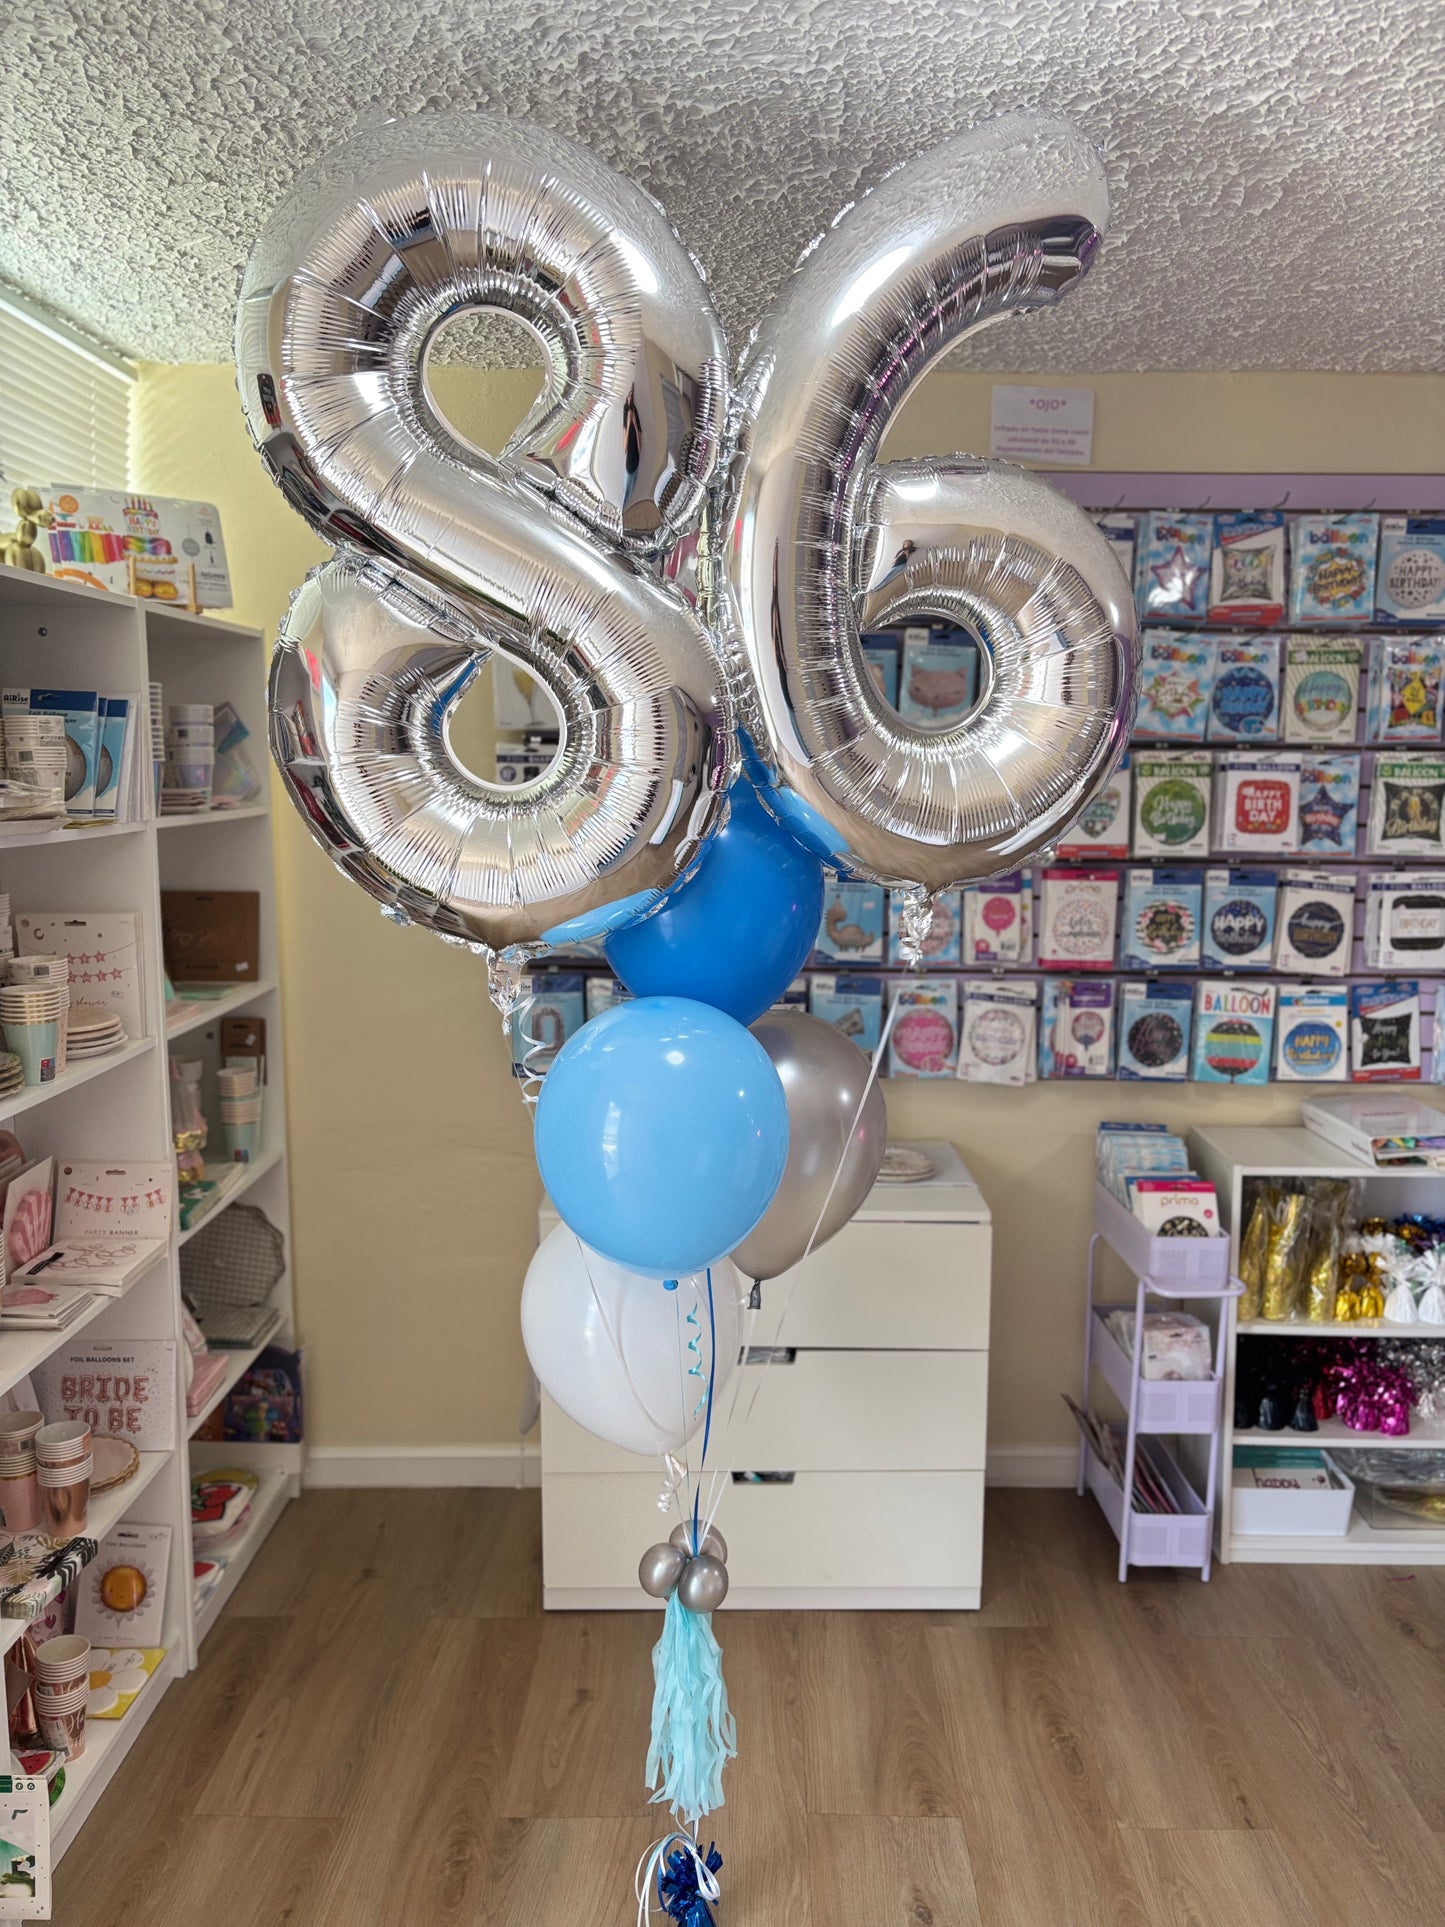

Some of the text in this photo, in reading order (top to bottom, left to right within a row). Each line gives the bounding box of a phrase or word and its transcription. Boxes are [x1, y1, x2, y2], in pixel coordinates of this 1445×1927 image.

[1399, 565, 1433, 576] HAPPY
[1302, 651, 1346, 662] ALLOON
[1244, 799, 1283, 811] BIRTH
[1248, 809, 1279, 823] DAY
[1411, 883, 1445, 891] BALLOO
[1204, 994, 1271, 1015] BALLOON
[1294, 1035, 1330, 1048] HAPPY
[62, 1375, 150, 1403] BRIDE
[64, 1406, 143, 1433] TO BE
